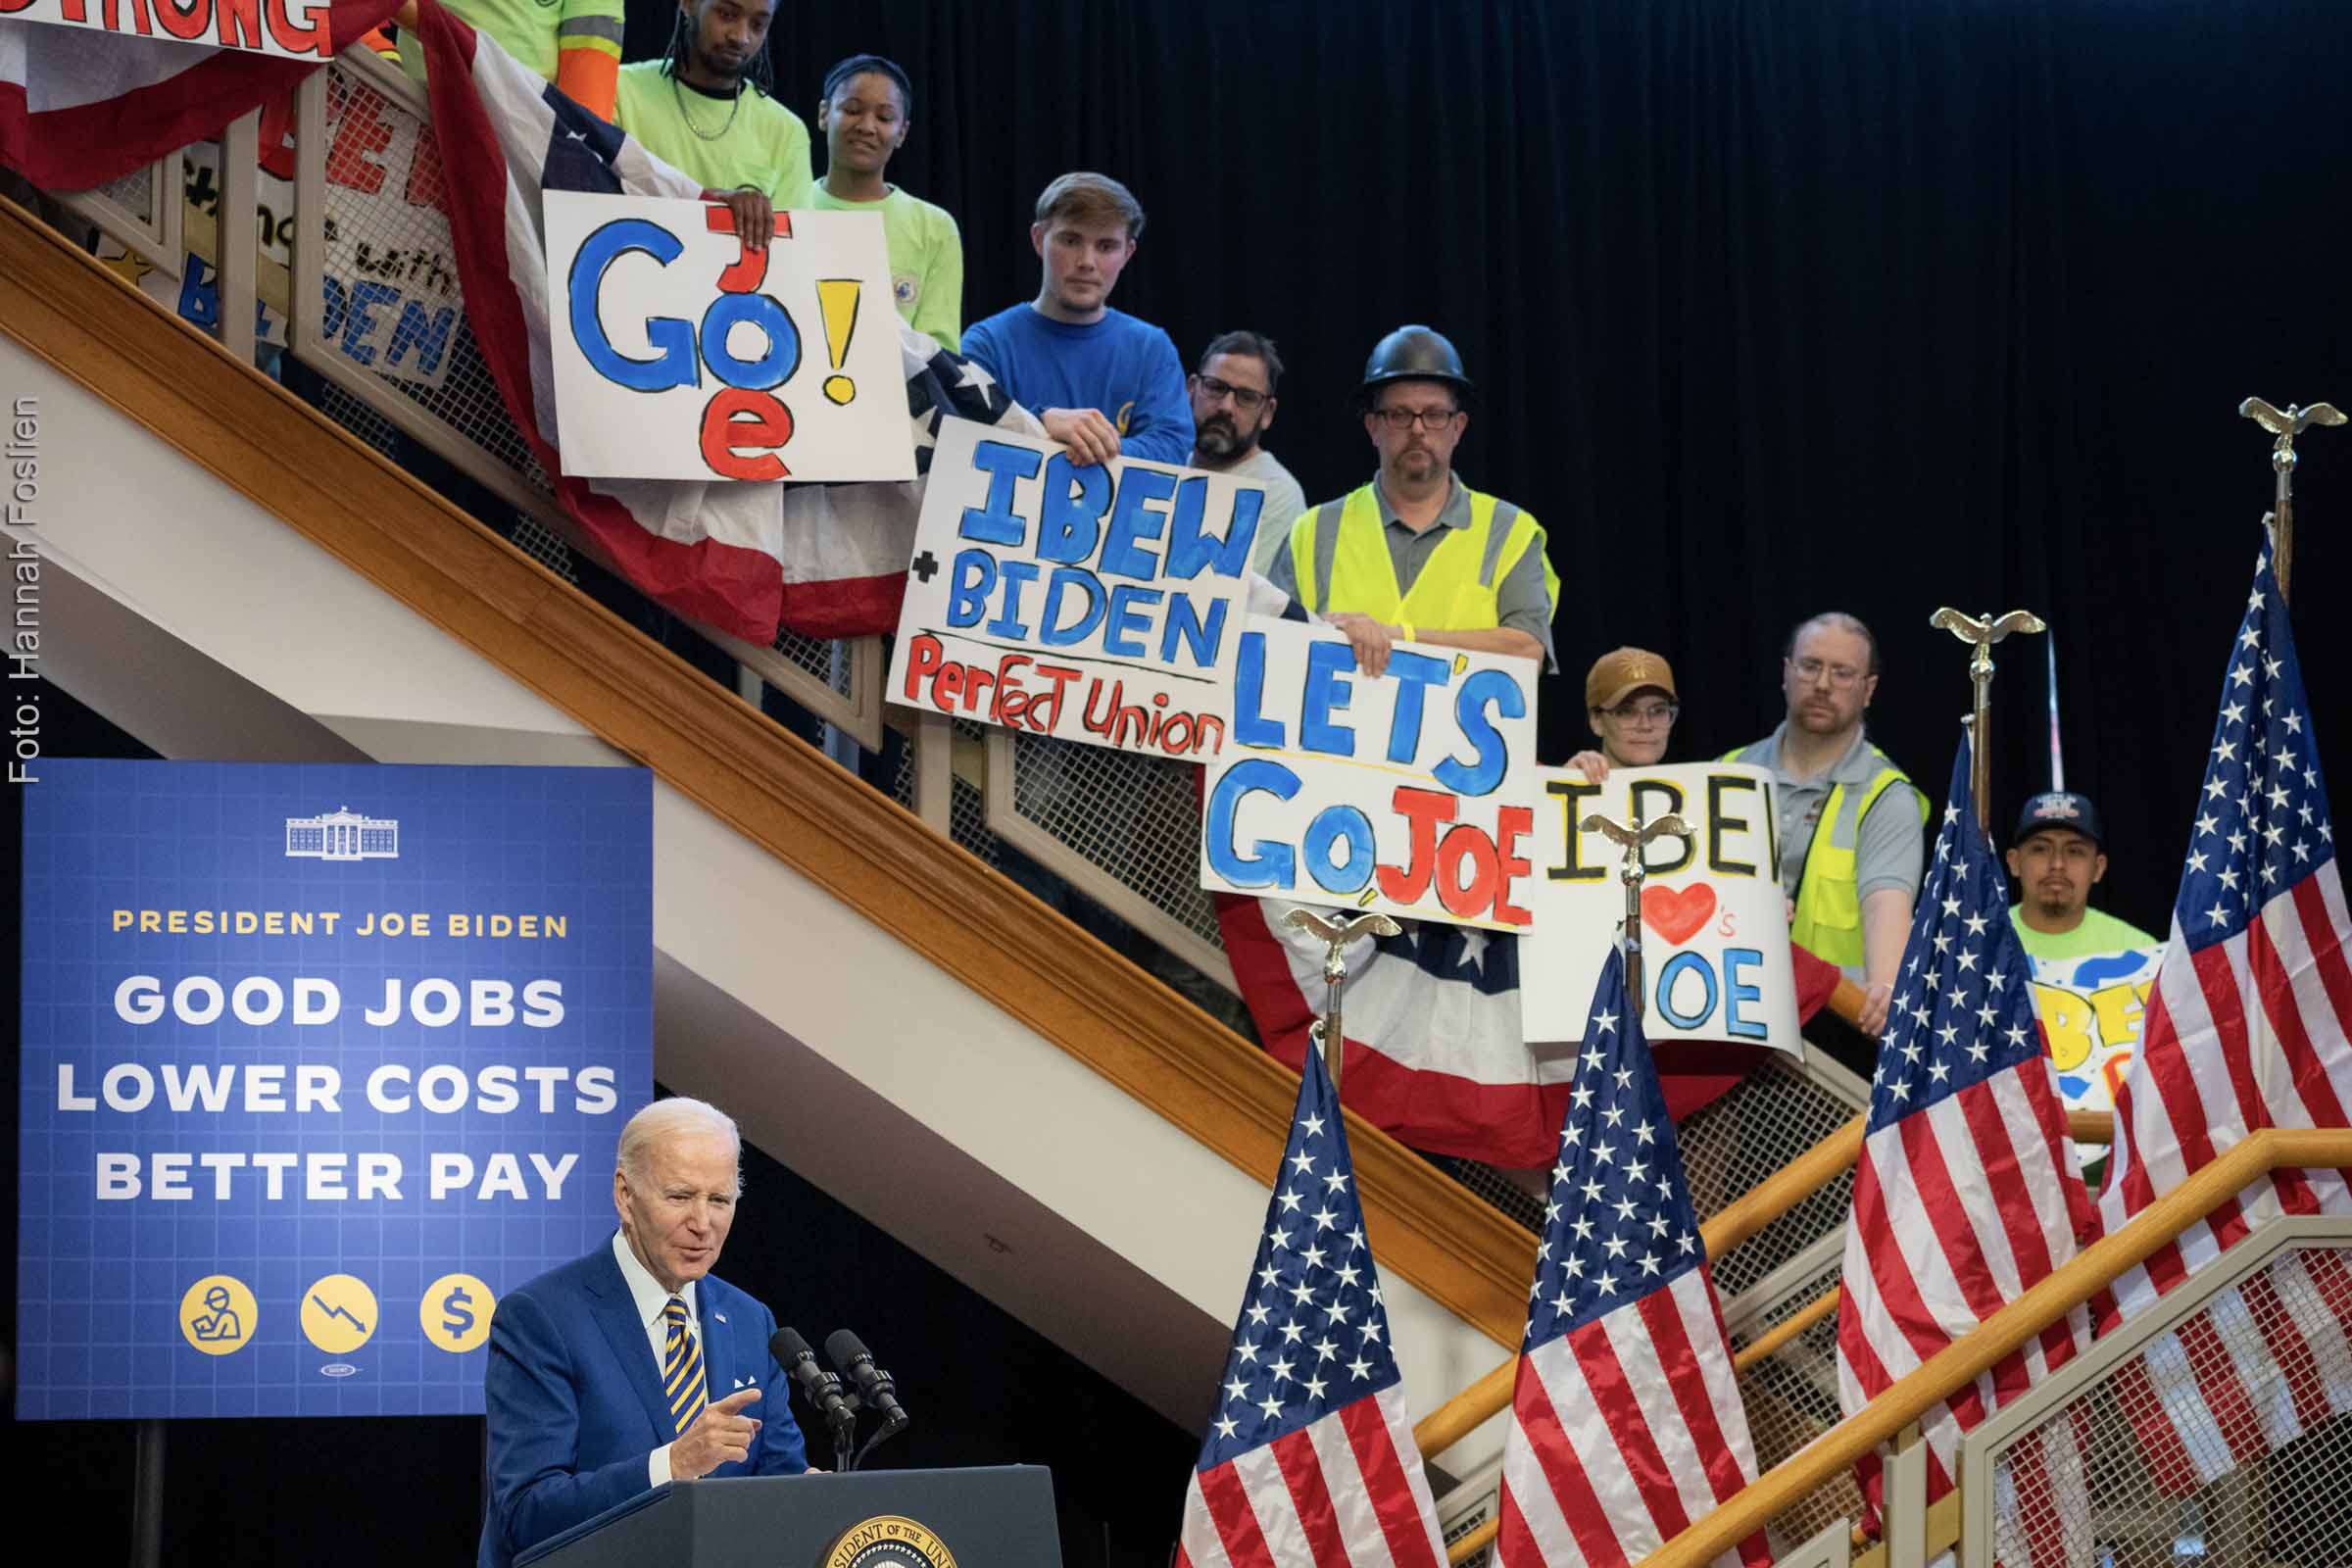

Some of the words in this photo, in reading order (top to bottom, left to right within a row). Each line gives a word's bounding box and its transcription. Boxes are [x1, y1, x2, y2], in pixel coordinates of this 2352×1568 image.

[177, 252, 455, 376] BEN
[958, 439, 1264, 582] IBEW
[947, 549, 1231, 667] BIDEN
[1082, 677, 1225, 756] Union
[1234, 632, 1526, 798] LET'S
[1376, 786, 1534, 926] JOE
[113, 909, 341, 936] PRESIDENT
[356, 911, 431, 937] JOE
[448, 913, 566, 938] BIDEN
[114, 975, 342, 1026] GOOD
[364, 978, 565, 1028] JOBS
[1642, 948, 1768, 1040] OE
[58, 1062, 343, 1113] LOWER
[366, 1064, 618, 1114] COSTS
[96, 1152, 404, 1200] BETTER
[429, 1152, 579, 1200] PAY
[886, 1524, 902, 1536] OF
[903, 1527, 922, 1544] THE
